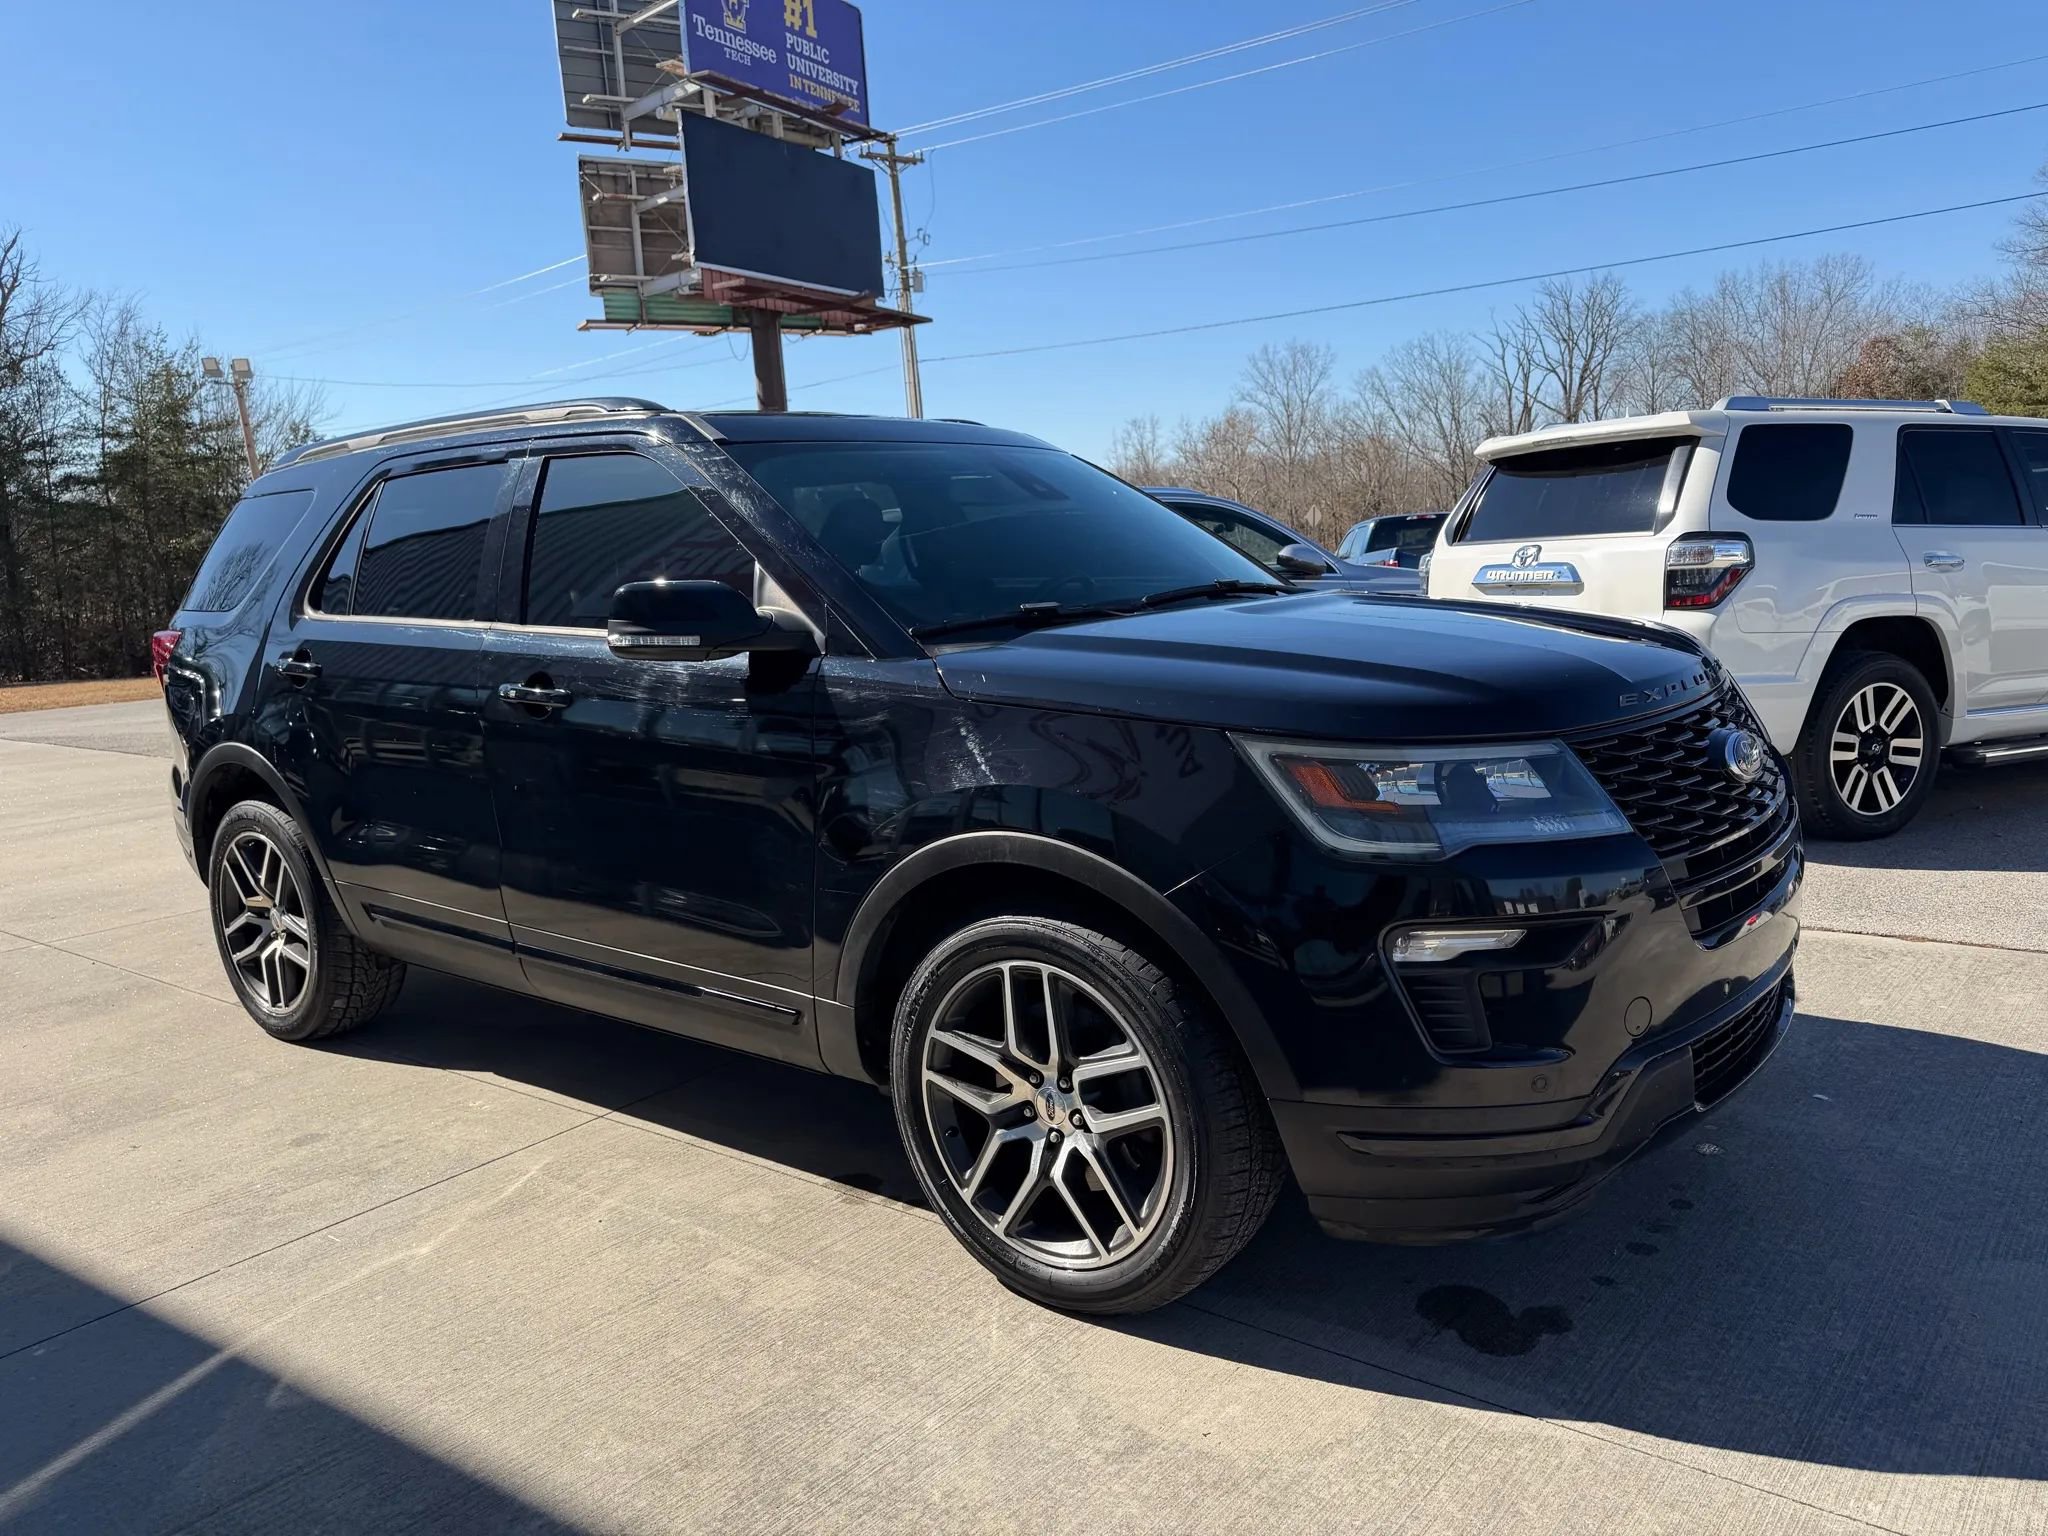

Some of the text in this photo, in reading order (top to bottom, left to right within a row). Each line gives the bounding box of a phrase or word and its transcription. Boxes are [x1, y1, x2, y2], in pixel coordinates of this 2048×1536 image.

[784, 0, 817, 38] #1
[692, 14, 777, 64] Tennessee
[724, 48, 751, 66] TECH
[785, 32, 830, 64] PUBLIC
[786, 53, 859, 95] UNIVERSITY
[789, 74, 802, 91] IN
[803, 80, 860, 113] TENNEEE
[1486, 569, 1554, 581] 4RUNNER
